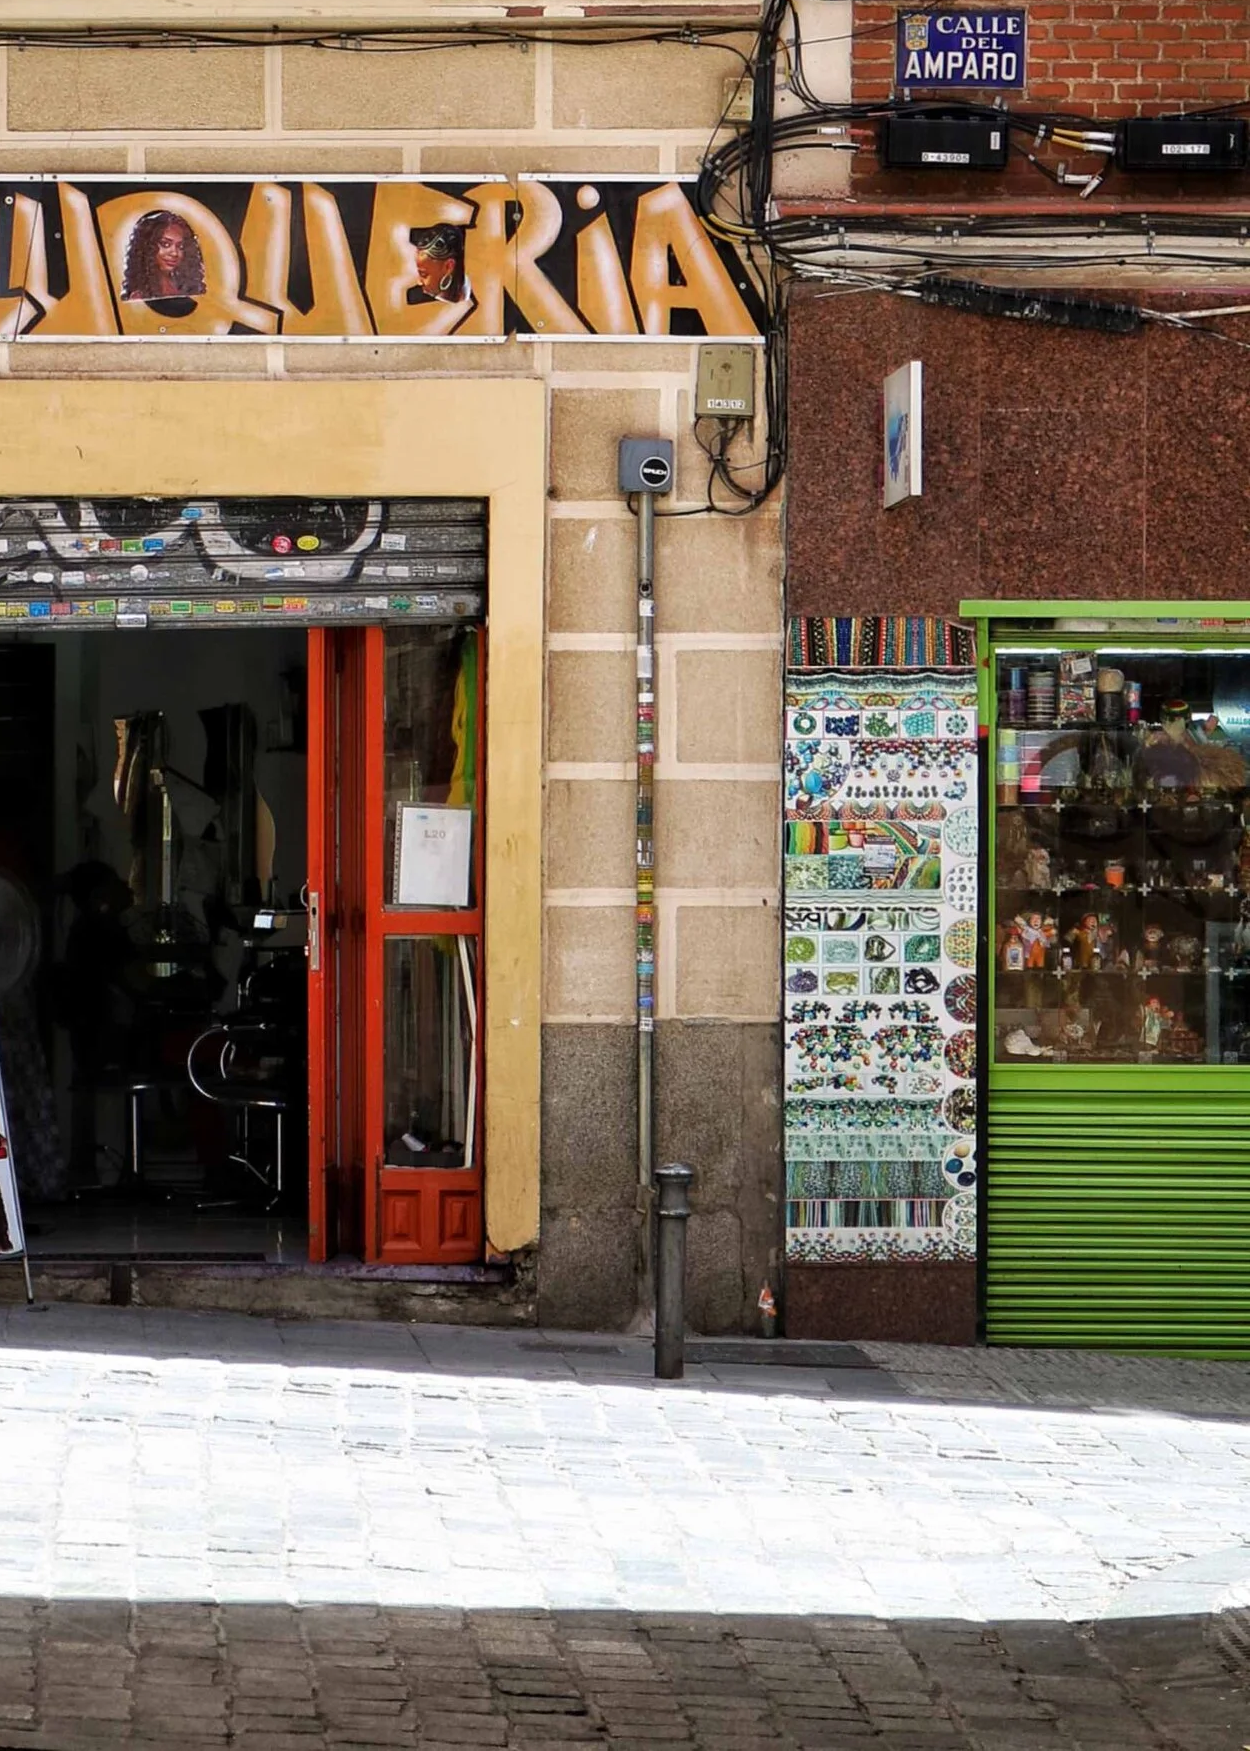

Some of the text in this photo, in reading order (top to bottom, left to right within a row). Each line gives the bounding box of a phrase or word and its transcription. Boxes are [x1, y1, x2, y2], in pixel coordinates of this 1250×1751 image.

[936, 16, 1021, 36] CALLE
[960, 36, 1004, 50] DEL
[904, 51, 1017, 81] AMPARO
